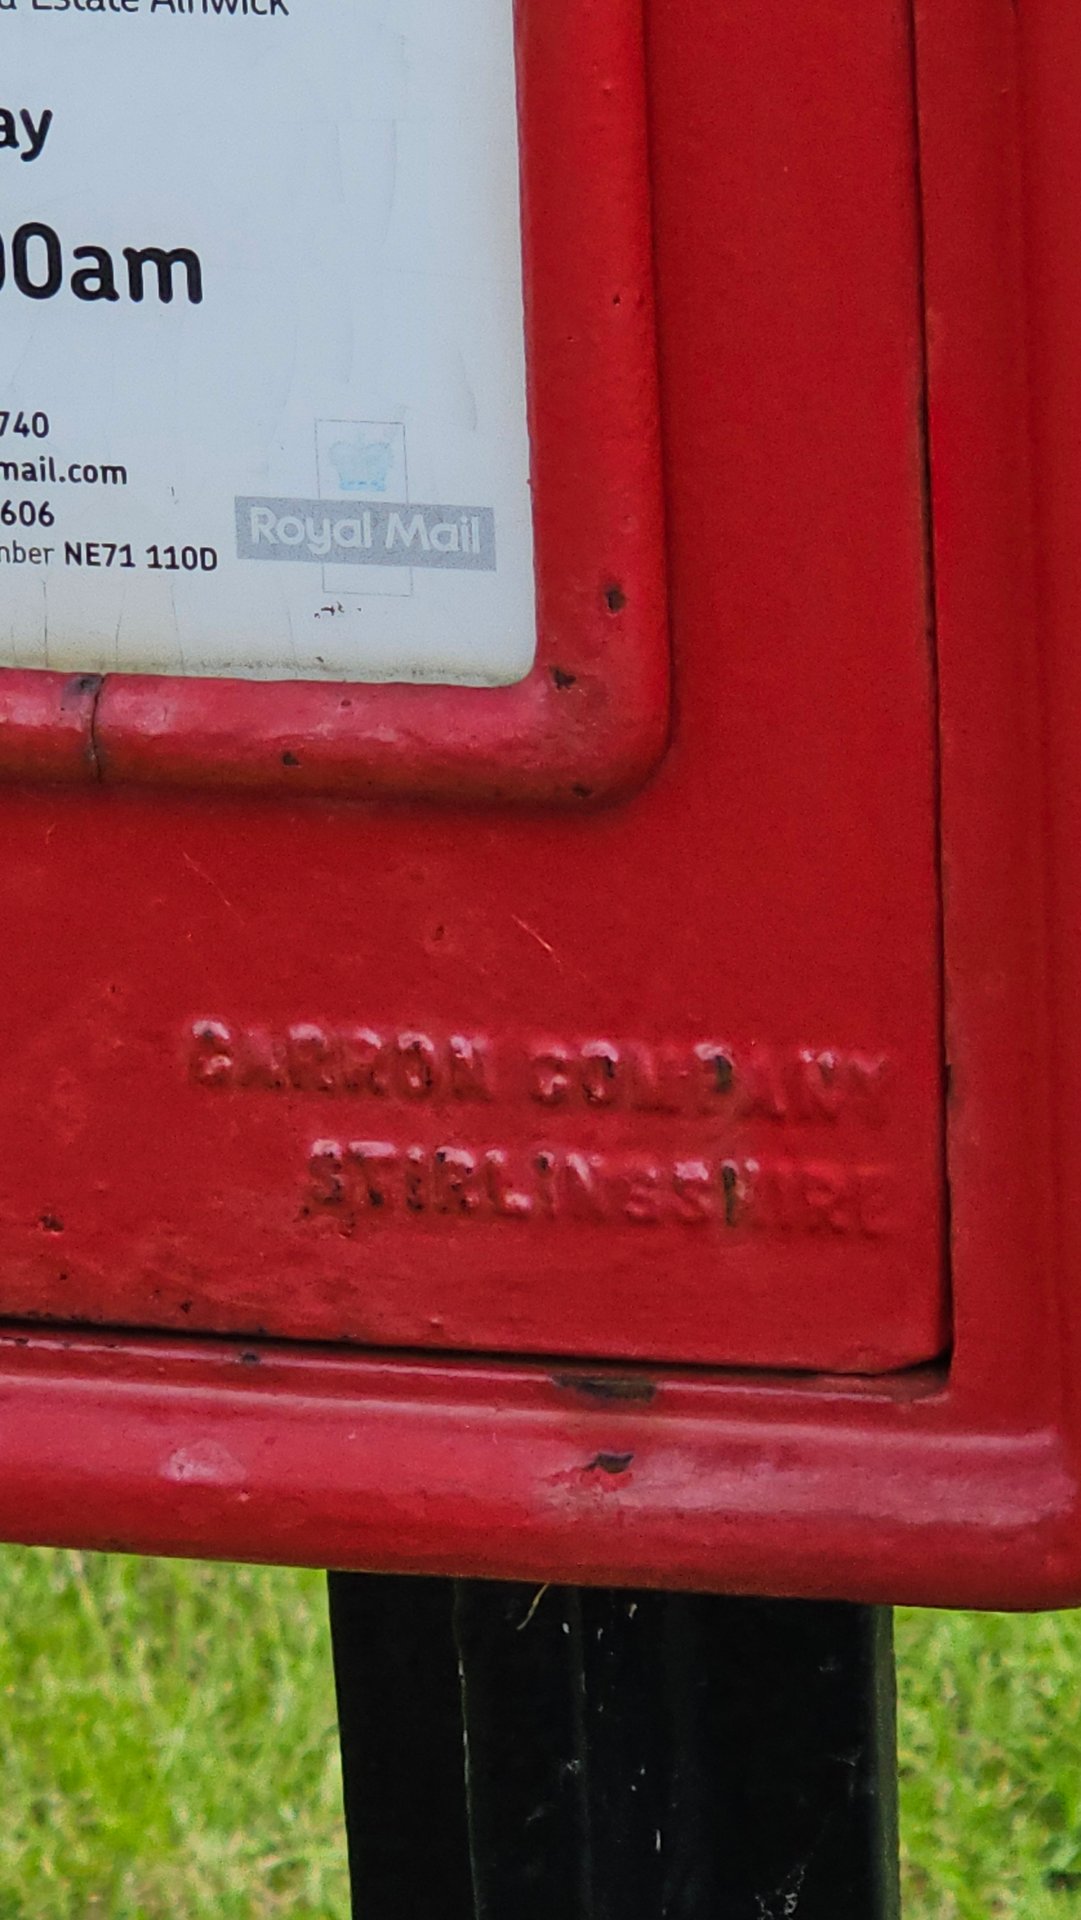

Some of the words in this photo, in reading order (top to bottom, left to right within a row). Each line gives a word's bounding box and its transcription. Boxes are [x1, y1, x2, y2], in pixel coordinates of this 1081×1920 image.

[0, 108, 53, 162] ay
[0, 222, 203, 304] 0am
[0, 411, 50, 439] 740
[0, 455, 127, 485] mail.com
[0, 500, 55, 528] 606
[250, 506, 372, 555] Royal
[385, 512, 481, 555] Mail
[64, 541, 136, 568] NE71
[146, 545, 218, 571] 110D
